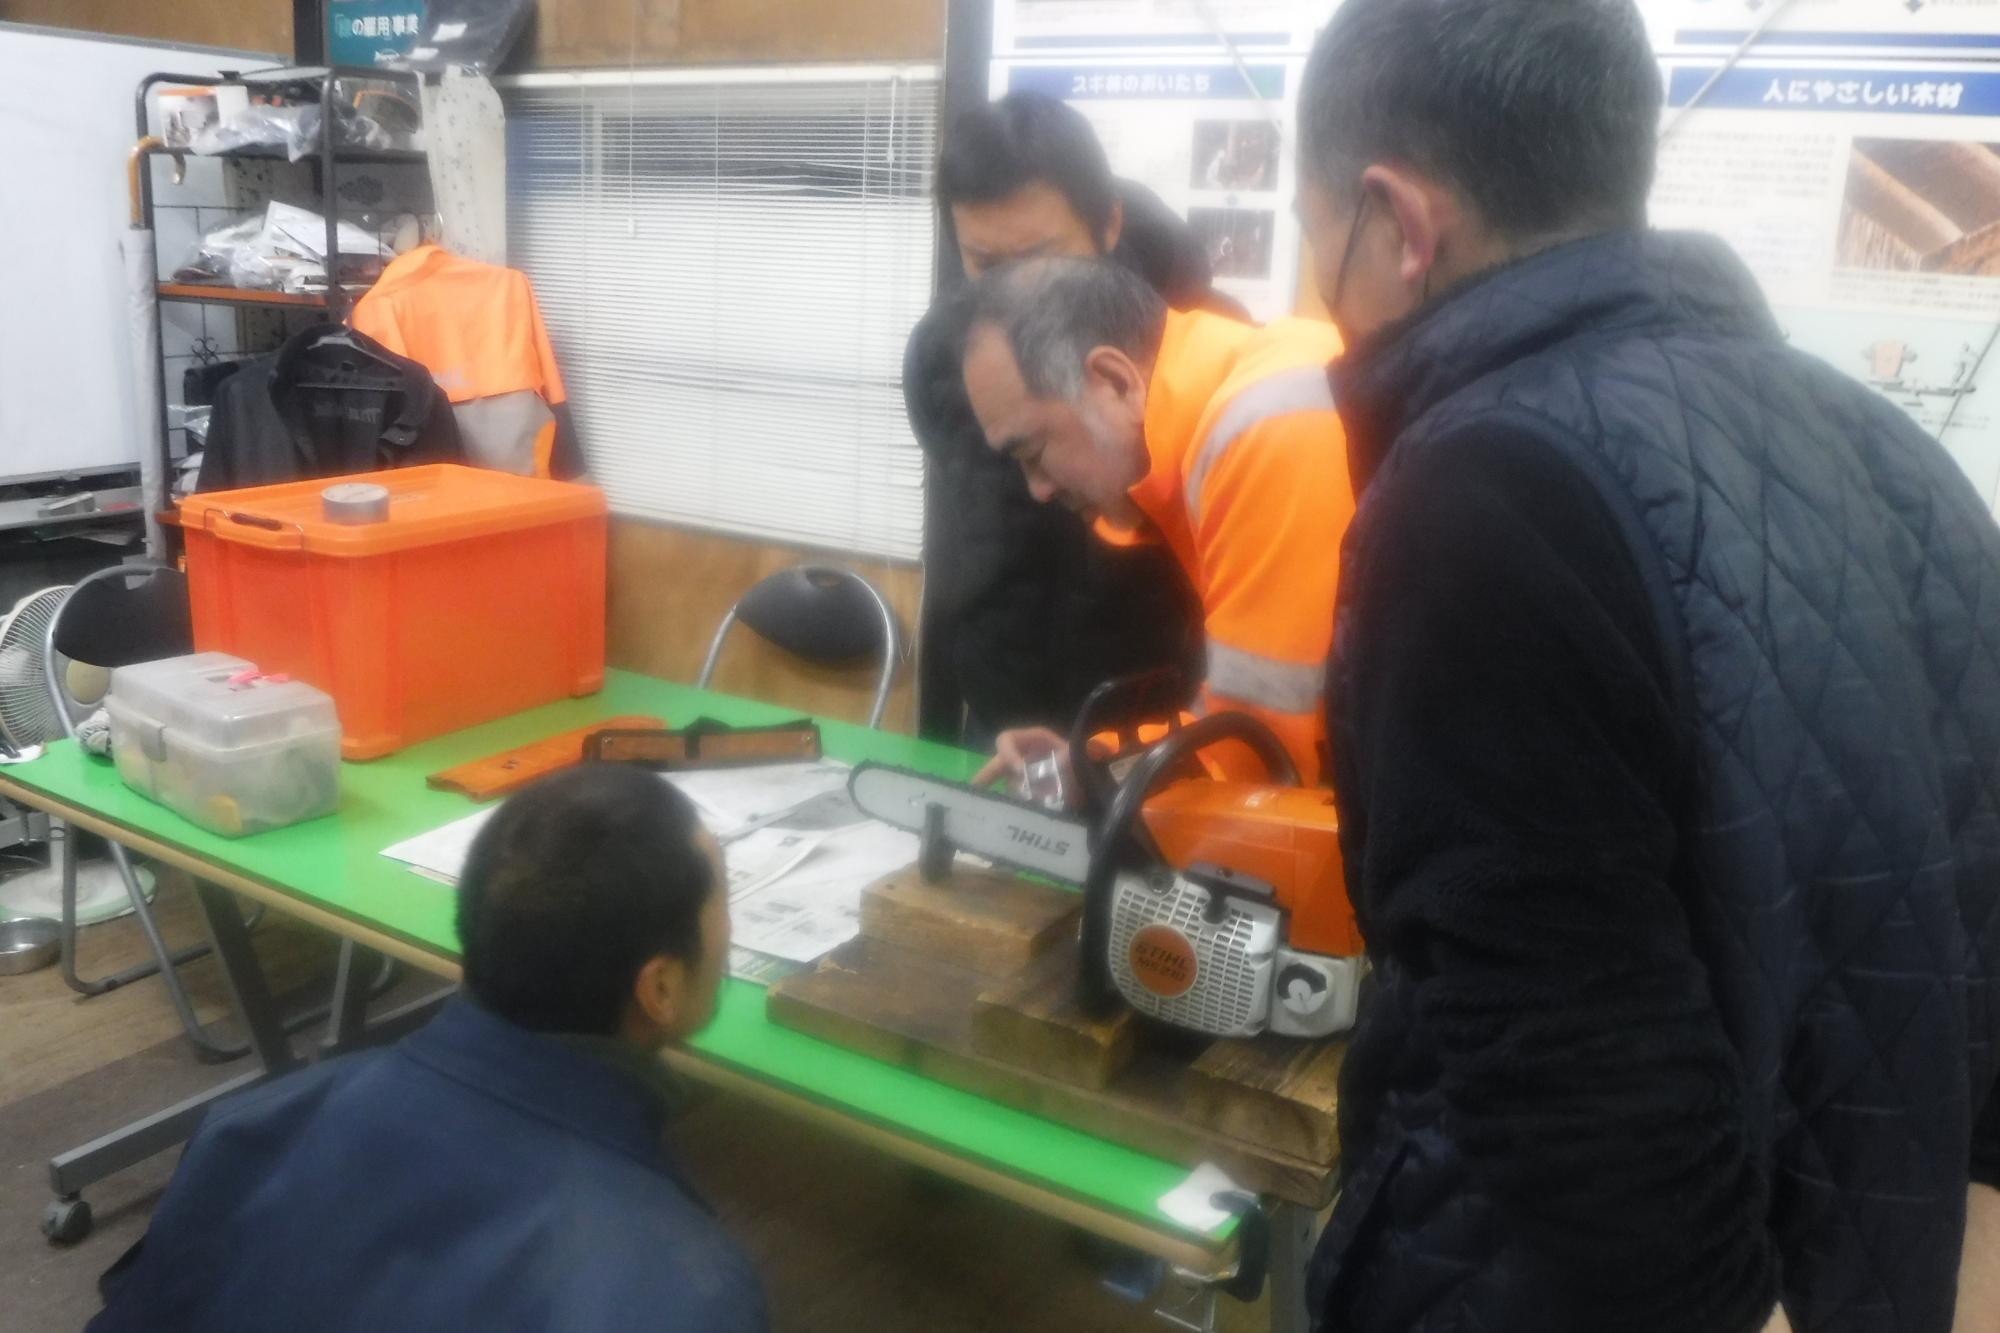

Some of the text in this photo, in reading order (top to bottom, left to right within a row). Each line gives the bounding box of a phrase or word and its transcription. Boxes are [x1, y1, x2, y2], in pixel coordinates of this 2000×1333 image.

[1763, 78, 1964, 108] 人にやさしい木材
[1007, 824, 1070, 855] STIHL
[1133, 941, 1192, 969] STIHL
